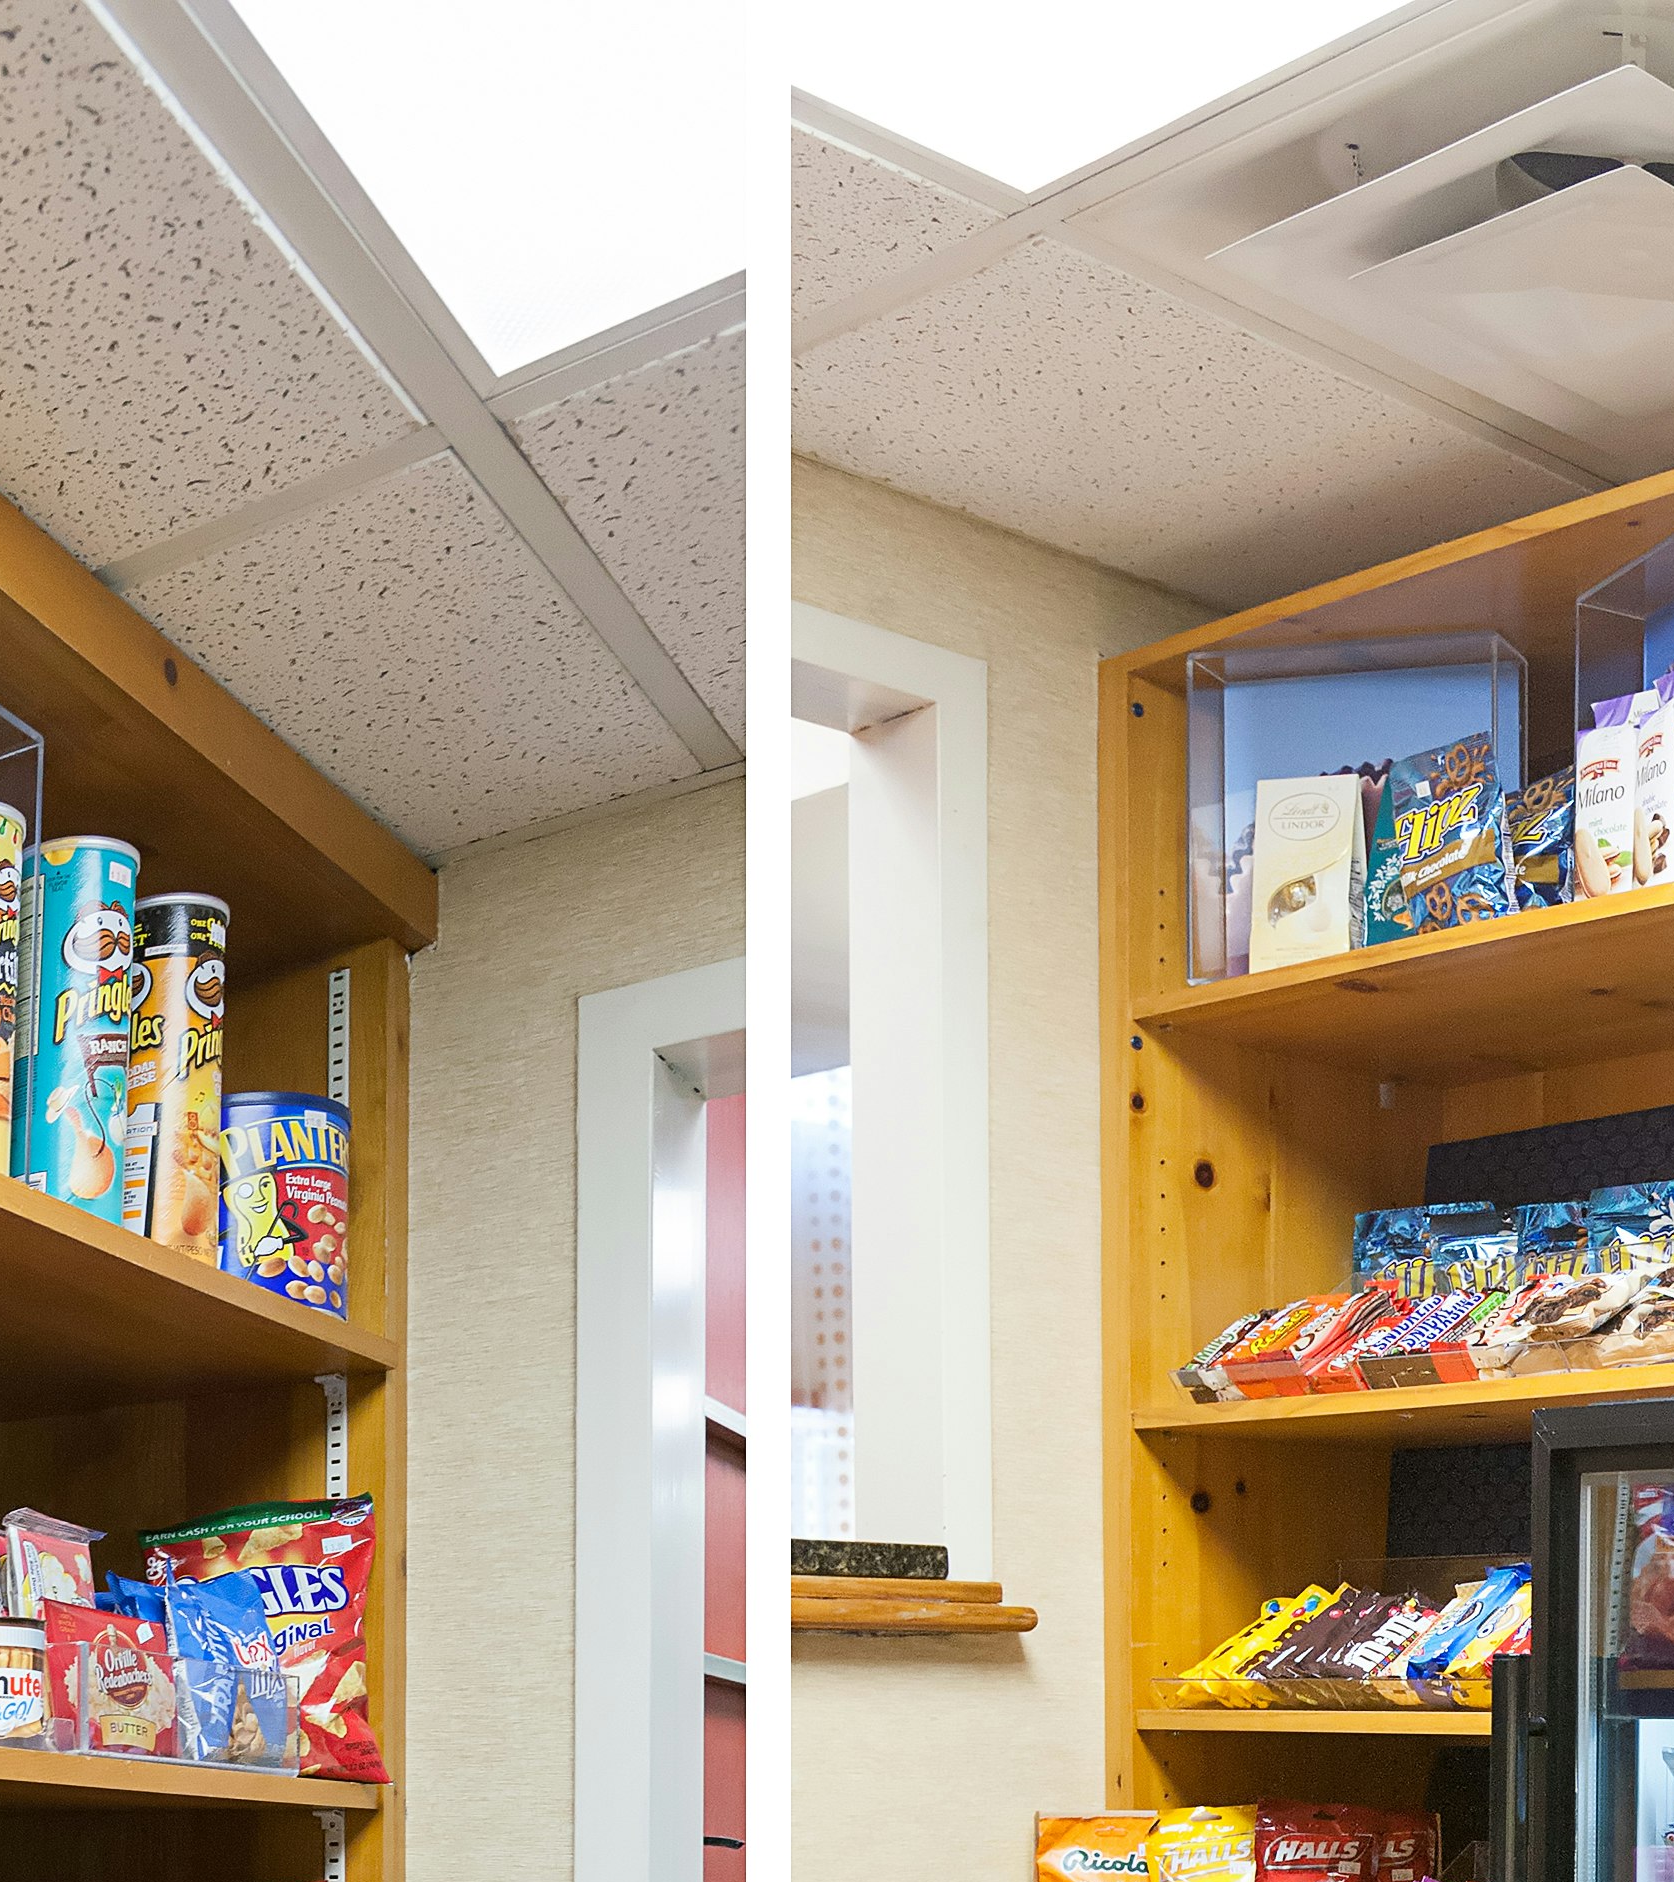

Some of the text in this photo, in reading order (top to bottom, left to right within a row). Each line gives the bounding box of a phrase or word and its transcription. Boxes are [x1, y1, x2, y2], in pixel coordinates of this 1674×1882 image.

[1577, 782, 1625, 810] Milano
[1280, 818, 1325, 832] LINDOR
[1394, 783, 1484, 863] Flipz
[285, 1172, 332, 1191] Extra Large
[285, 1186, 324, 1204] Virginia
[145, 1508, 325, 1544] EARN CASH FOR YOUR SCHOOL!
[110, 1721, 149, 1738] BUTTER
[1169, 1839, 1252, 1874] HALLS
[1276, 1838, 1362, 1865] HALLS
